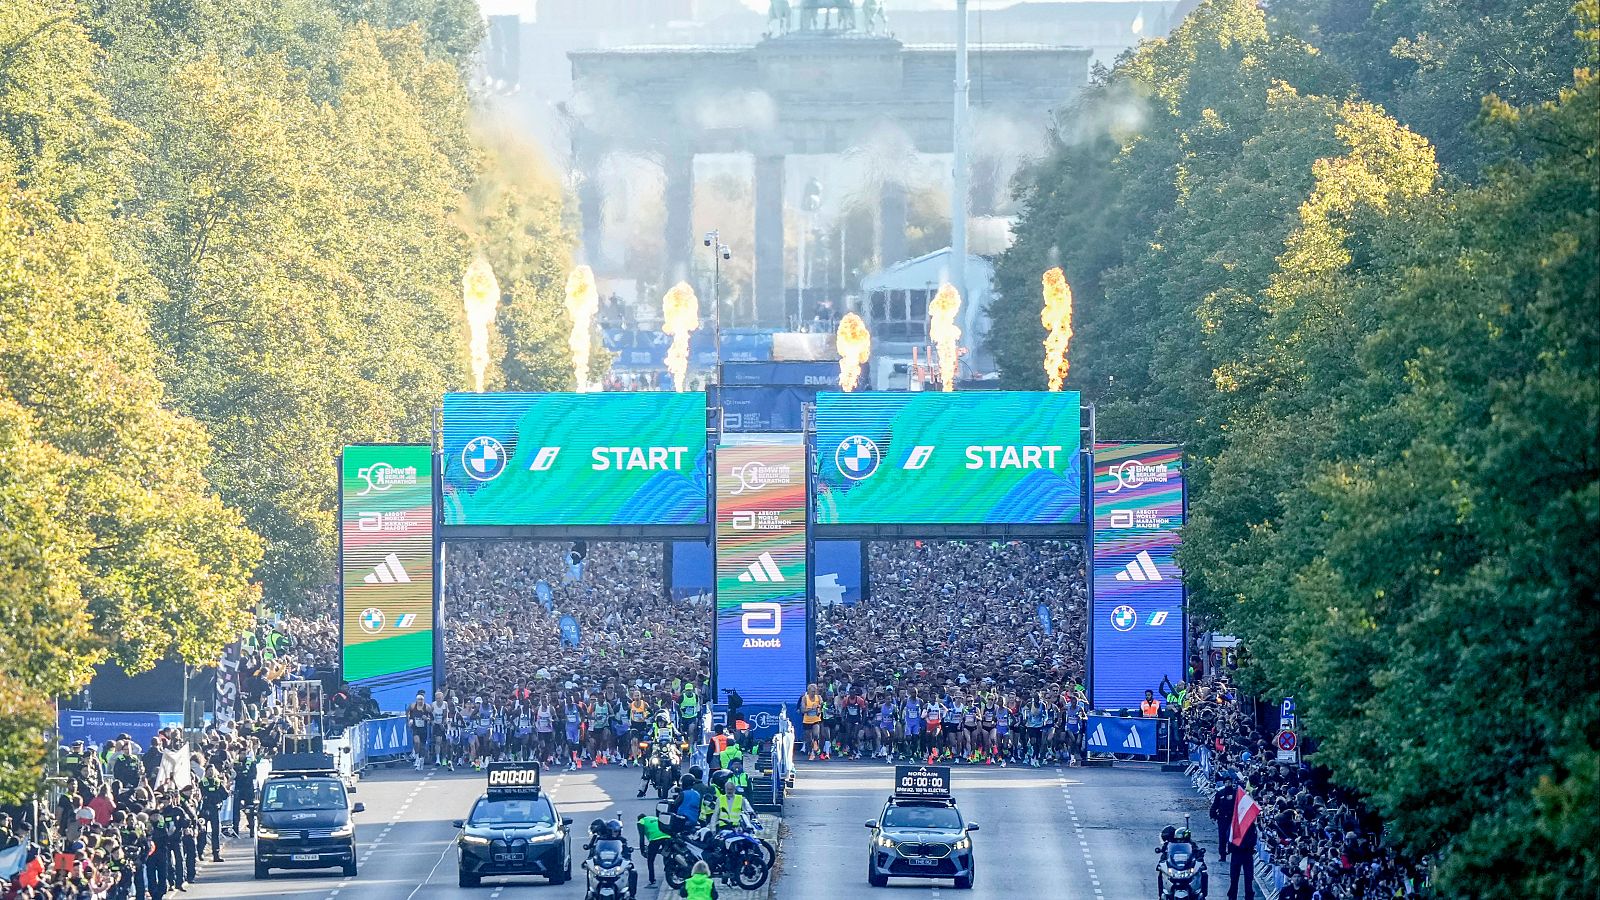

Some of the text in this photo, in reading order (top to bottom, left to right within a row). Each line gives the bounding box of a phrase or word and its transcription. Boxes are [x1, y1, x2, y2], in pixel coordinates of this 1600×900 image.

[591, 446, 689, 470] START
[965, 445, 1062, 469] START
[357, 462, 393, 496] 50
[730, 461, 766, 495] 50
[1107, 460, 1144, 493] 50
[742, 638, 782, 648] Abbott
[1283, 700, 1290, 716] P
[490, 770, 535, 784] 0:00:00
[902, 777, 942, 787] 00:00:00
